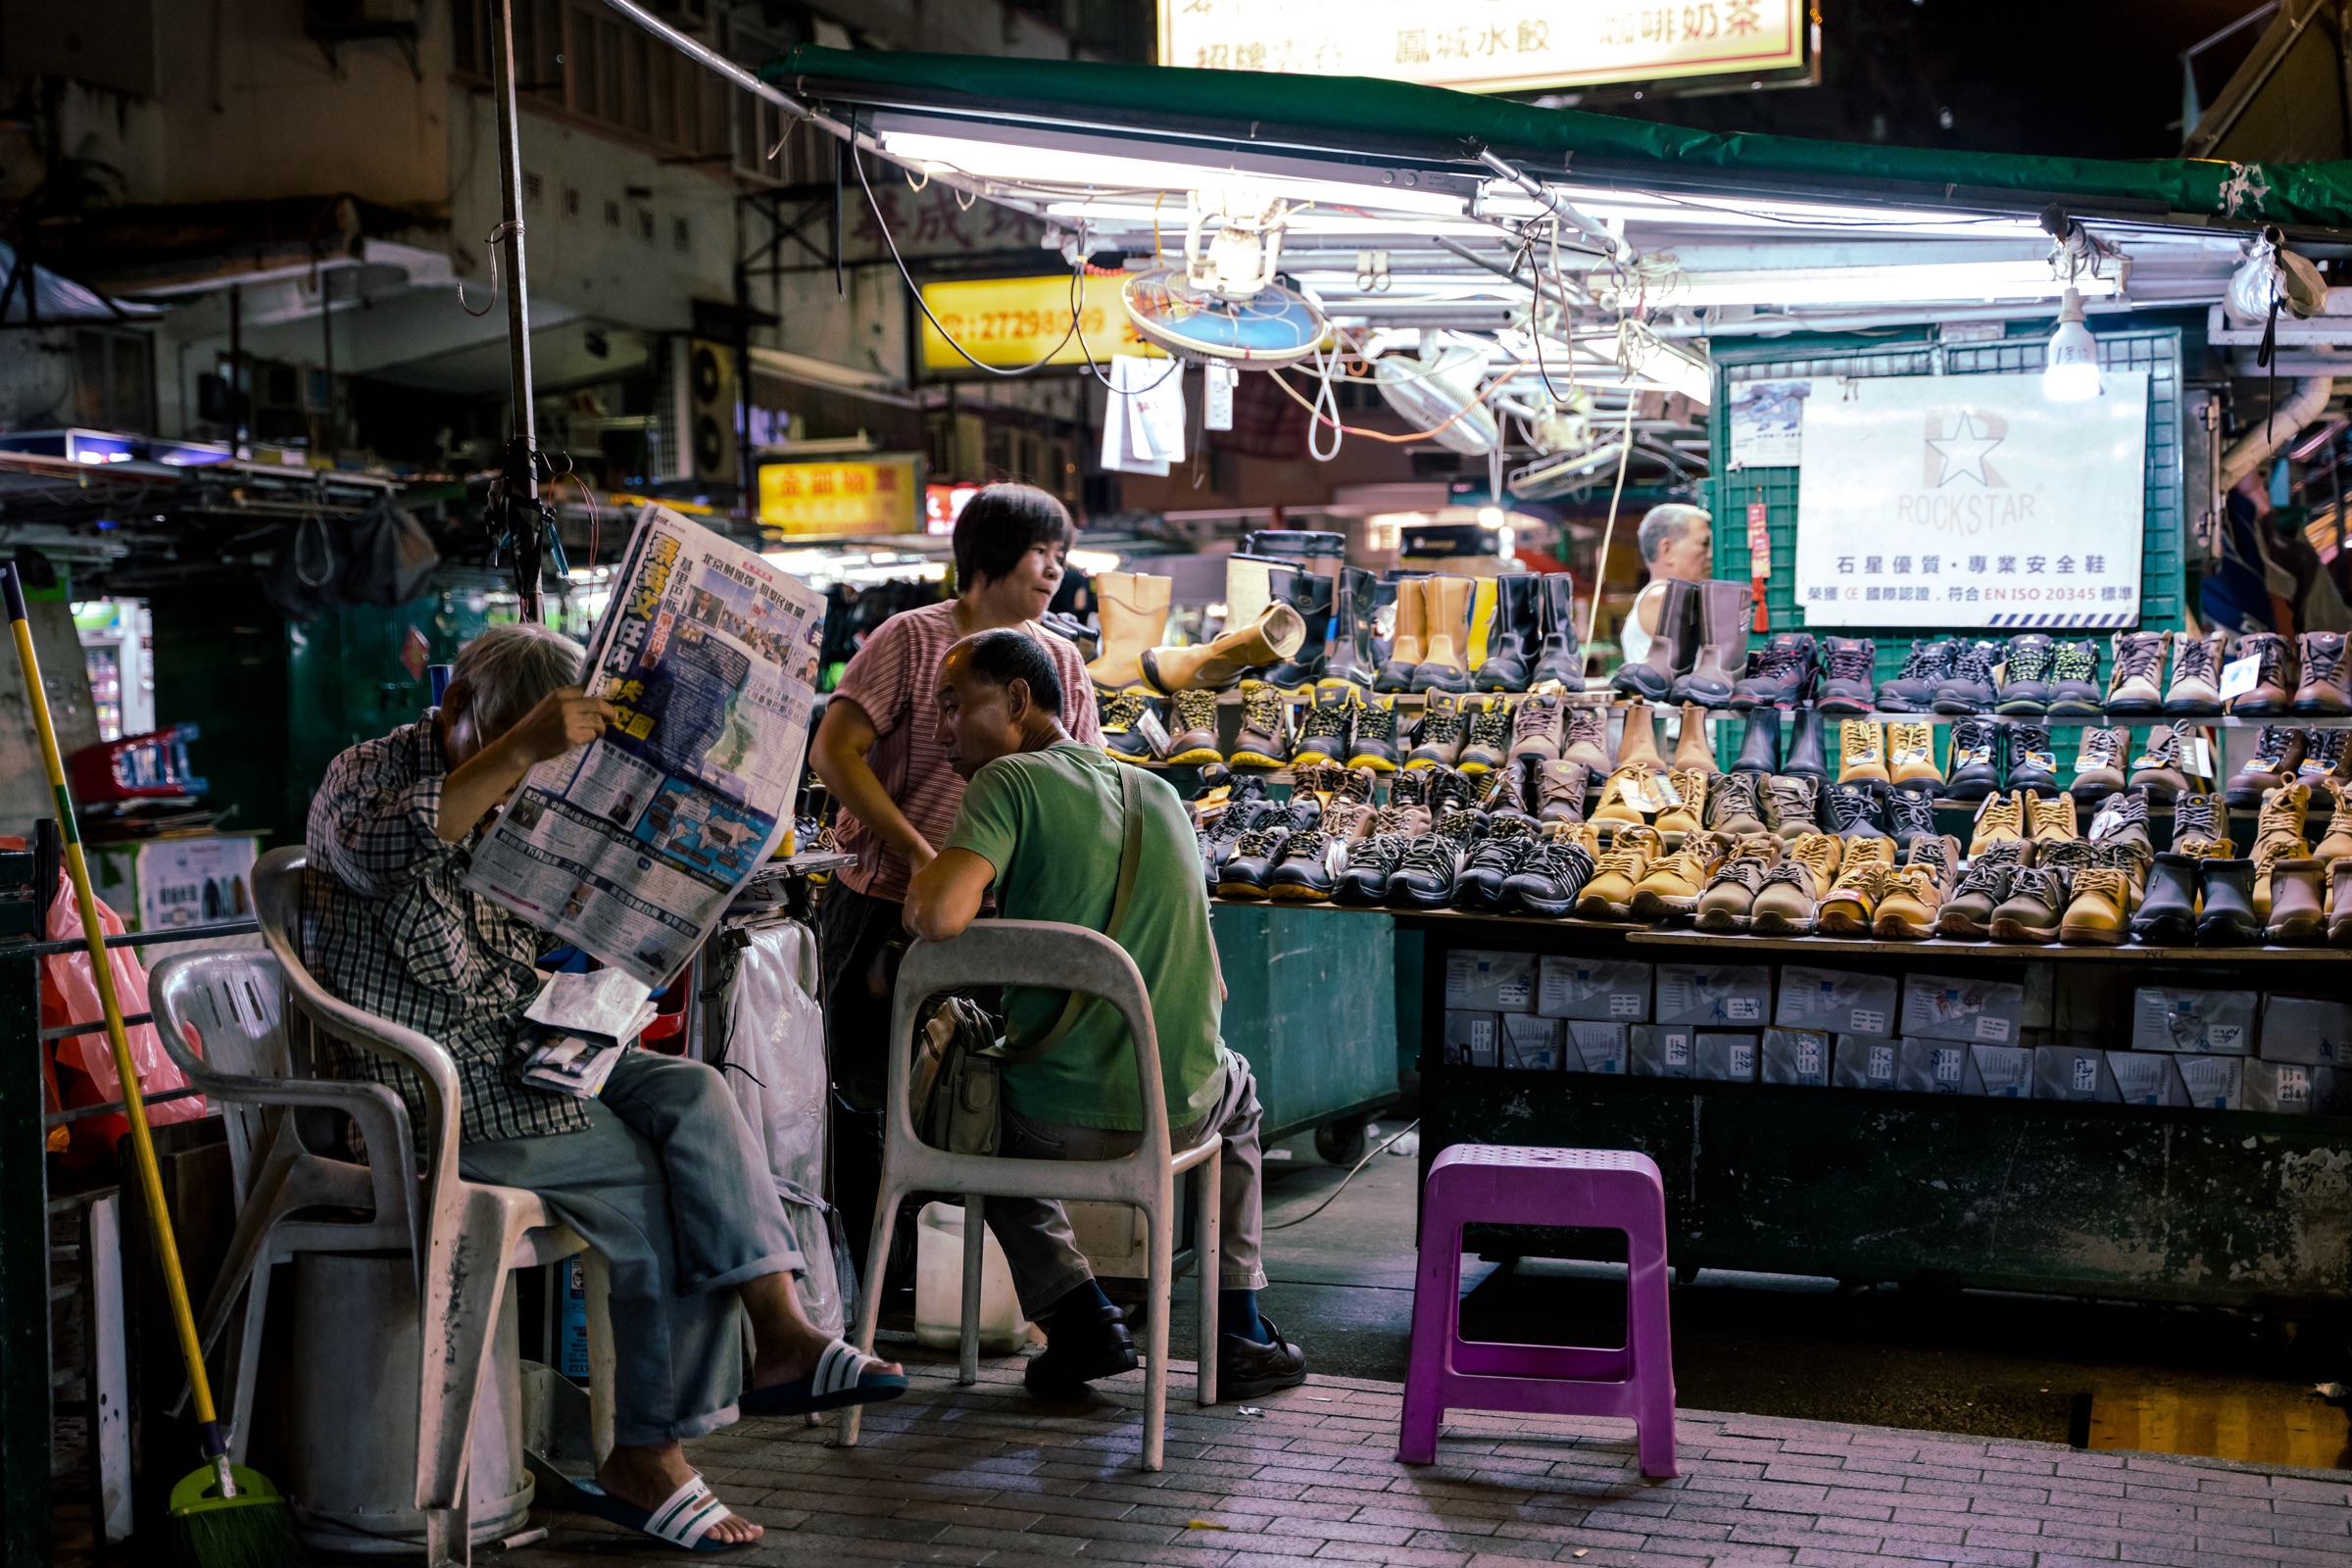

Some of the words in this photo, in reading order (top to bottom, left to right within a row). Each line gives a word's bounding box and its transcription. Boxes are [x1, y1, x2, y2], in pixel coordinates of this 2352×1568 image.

[1897, 492, 2035, 537] ROCKSTAR
[603, 529, 682, 674] 蔡英文任內
[700, 551, 757, 588] 北京射銀彈
[757, 581, 807, 620] 狙擊民進黨
[1984, 587, 2007, 602] EN
[2011, 587, 2041, 602] ISO
[2045, 587, 2096, 602] 20345
